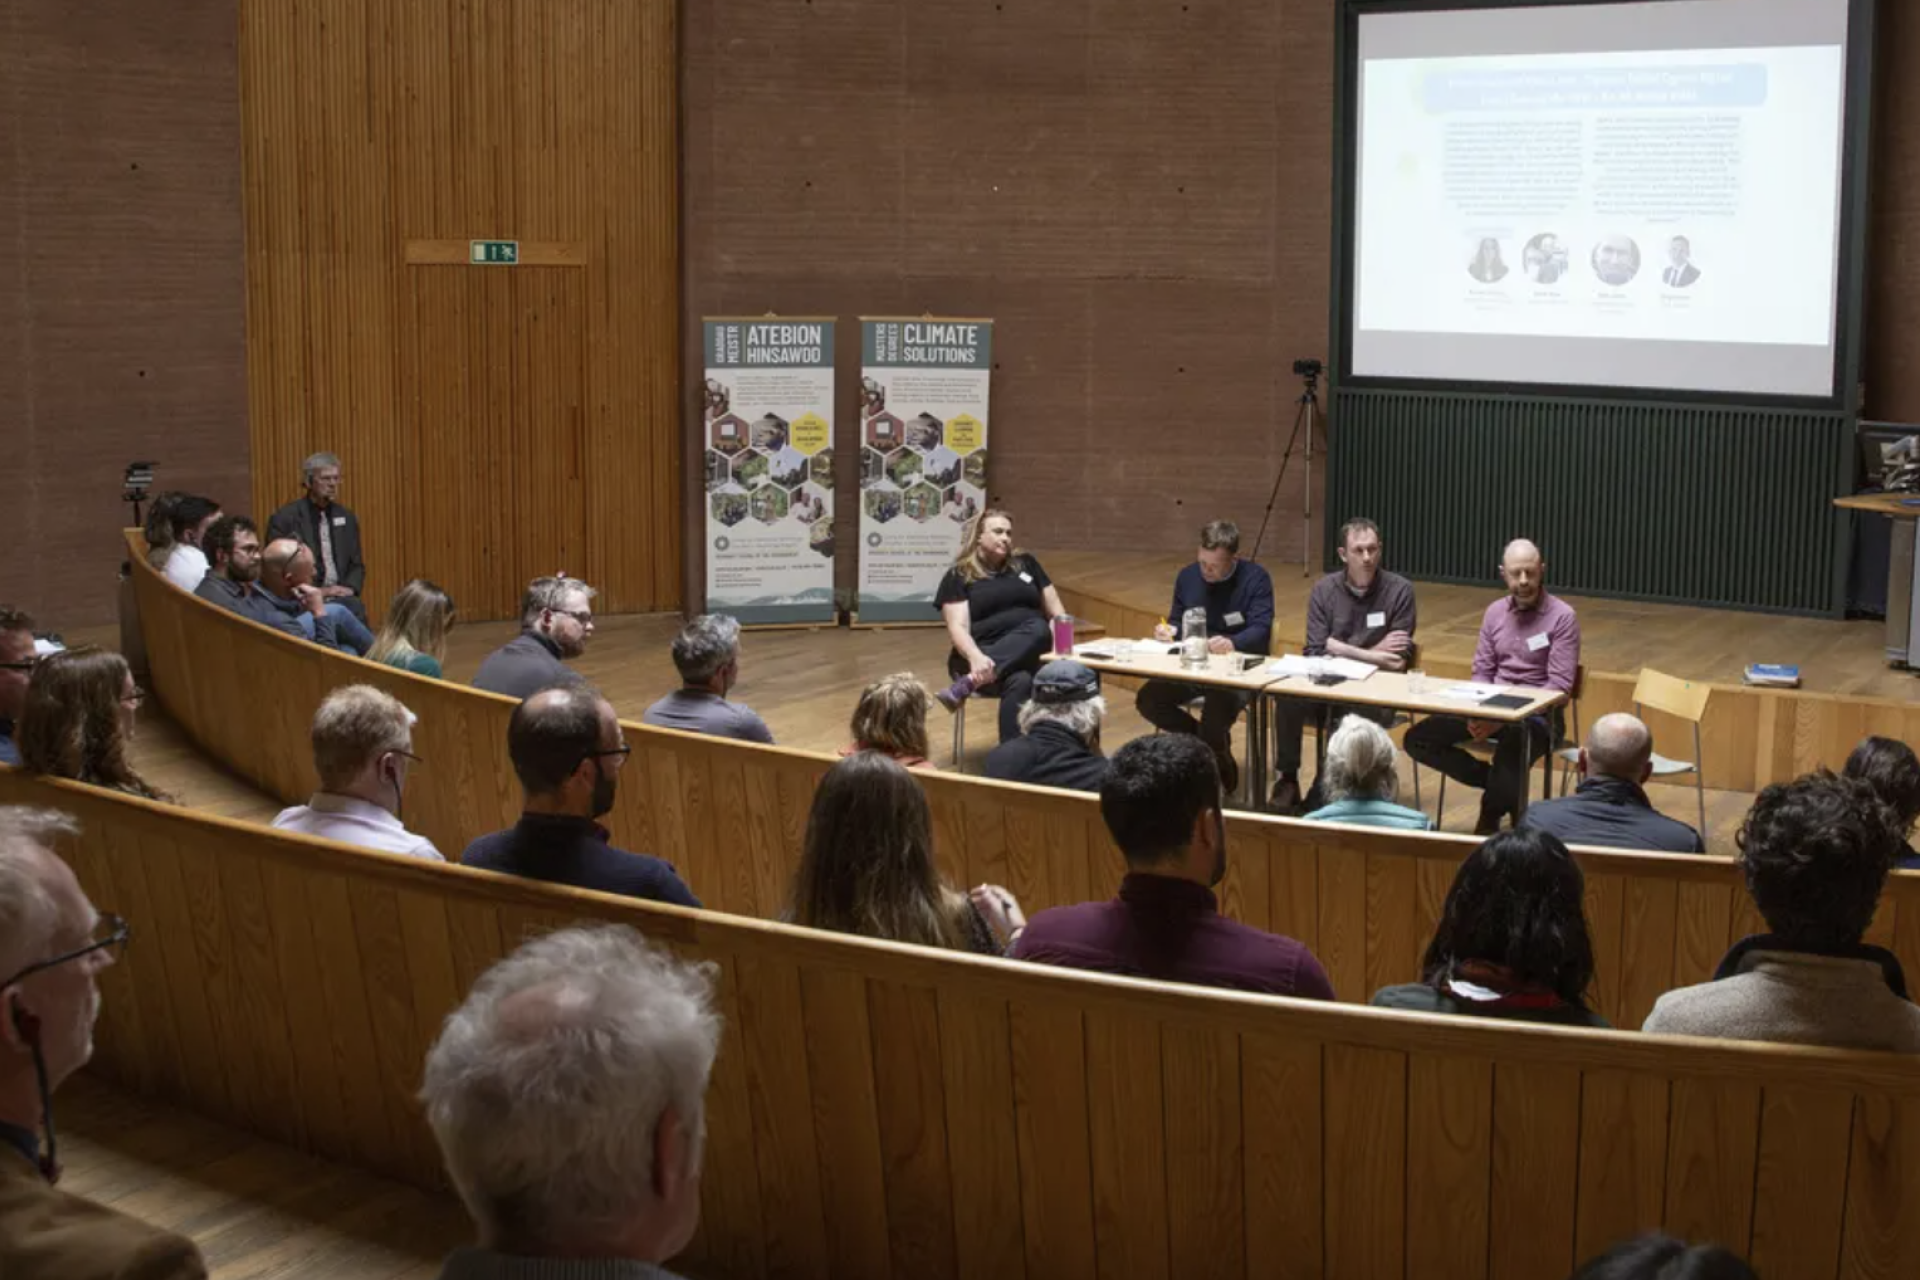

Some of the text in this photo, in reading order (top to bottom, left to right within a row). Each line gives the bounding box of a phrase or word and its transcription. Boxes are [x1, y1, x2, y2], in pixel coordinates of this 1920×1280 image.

[747, 325, 821, 345] ATEBION
[904, 324, 978, 345] CLIMATE
[903, 346, 976, 363] SOLUTIONS
